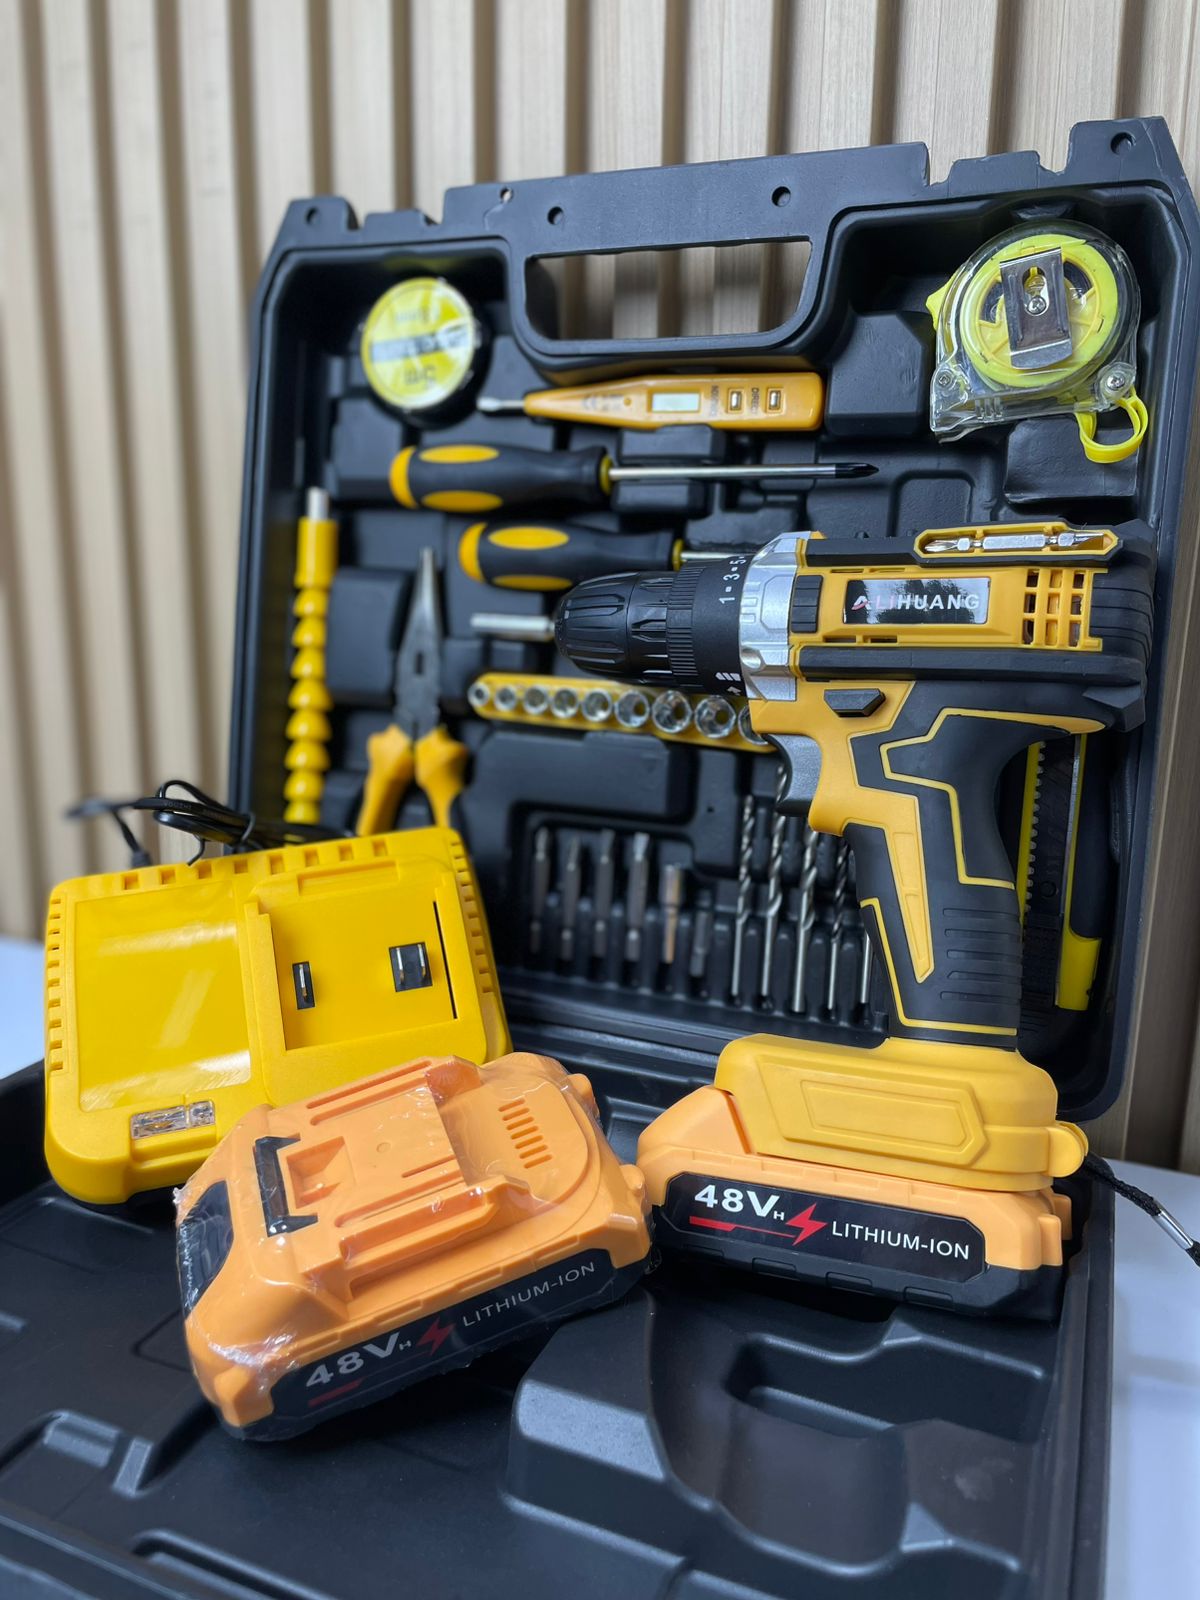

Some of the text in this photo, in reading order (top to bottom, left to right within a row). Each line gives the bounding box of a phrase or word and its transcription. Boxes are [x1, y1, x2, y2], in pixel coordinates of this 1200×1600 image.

[722, 573, 740, 581] 3
[851, 593, 981, 611] ALIHUANG
[831, 1220, 970, 1260] LITHIUM-ION
[462, 1261, 596, 1327] LITHIUM-ION
